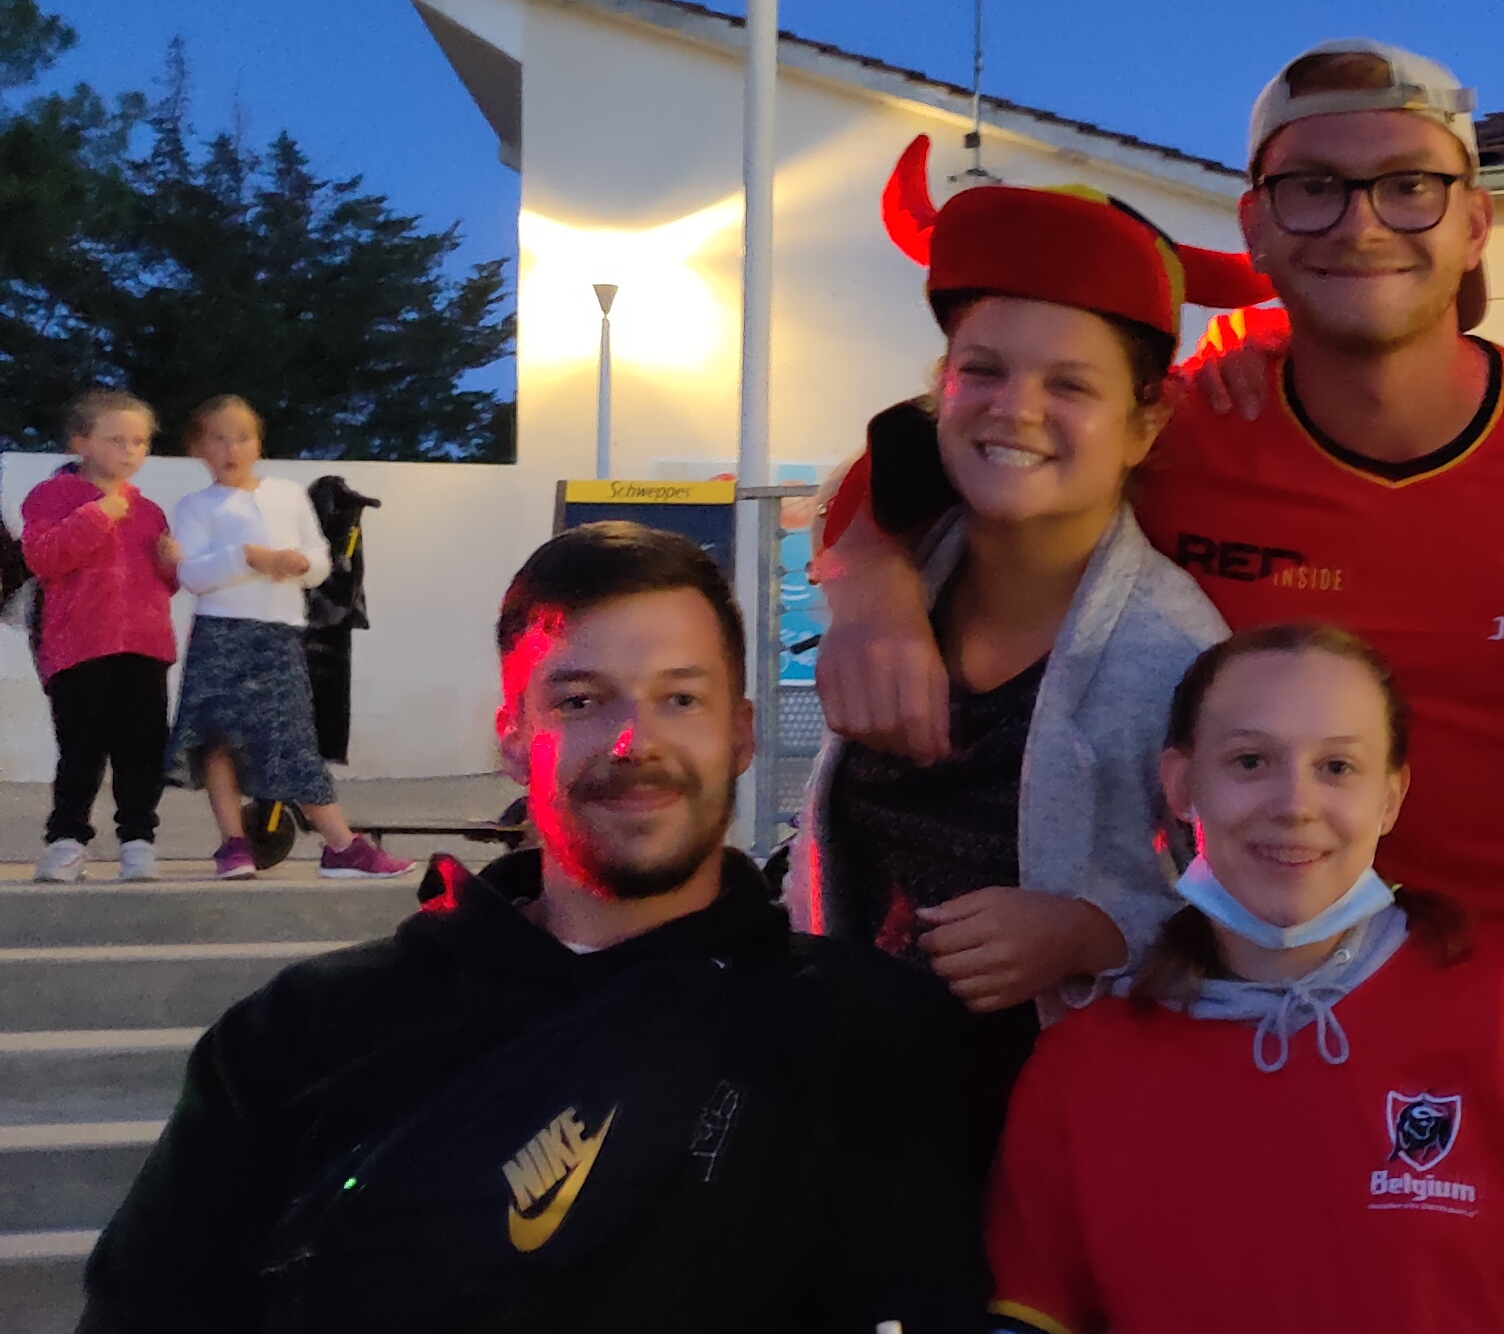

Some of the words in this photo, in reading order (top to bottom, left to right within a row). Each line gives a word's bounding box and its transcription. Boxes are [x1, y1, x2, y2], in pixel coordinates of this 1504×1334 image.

[609, 480, 691, 501] Schweppes
[1272, 566, 1345, 593] INSIDE
[501, 1105, 594, 1212] NIKE
[1369, 1169, 1476, 1202] Belgium
